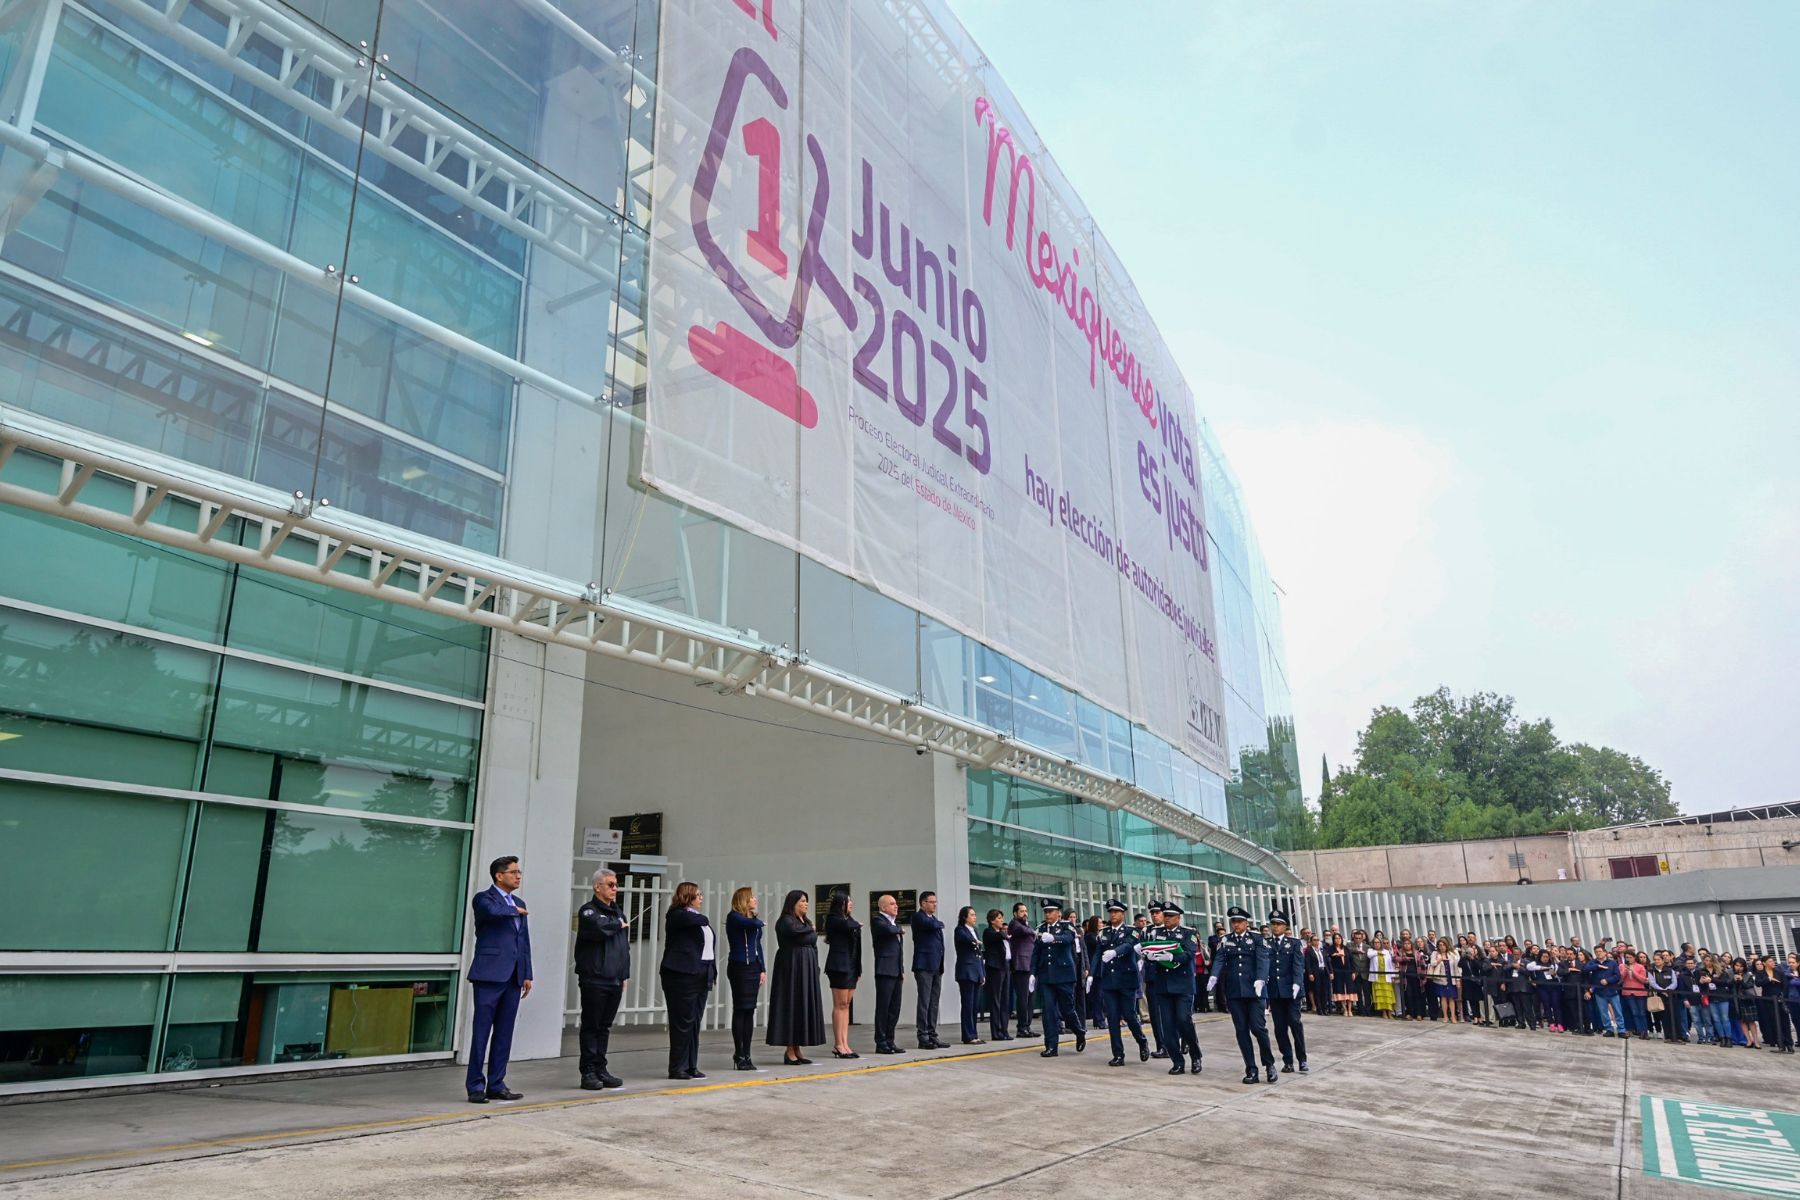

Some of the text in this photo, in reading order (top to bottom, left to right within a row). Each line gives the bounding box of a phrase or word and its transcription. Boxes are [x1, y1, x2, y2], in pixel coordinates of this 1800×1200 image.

[742, 117, 788, 280] 1
[852, 157, 987, 364] Junio
[975, 96, 1157, 429] Mexiquense
[849, 405, 884, 443] Proceso
[885, 432, 920, 469] Electoral
[852, 272, 991, 475] 2025
[877, 453, 901, 481] 2025
[901, 468, 914, 491] del
[914, 478, 941, 508] Estado
[1024, 453, 1055, 527] hay
[1059, 490, 1114, 566] elección
[1116, 538, 1130, 580] de
[1137, 440, 1207, 572] es justo
